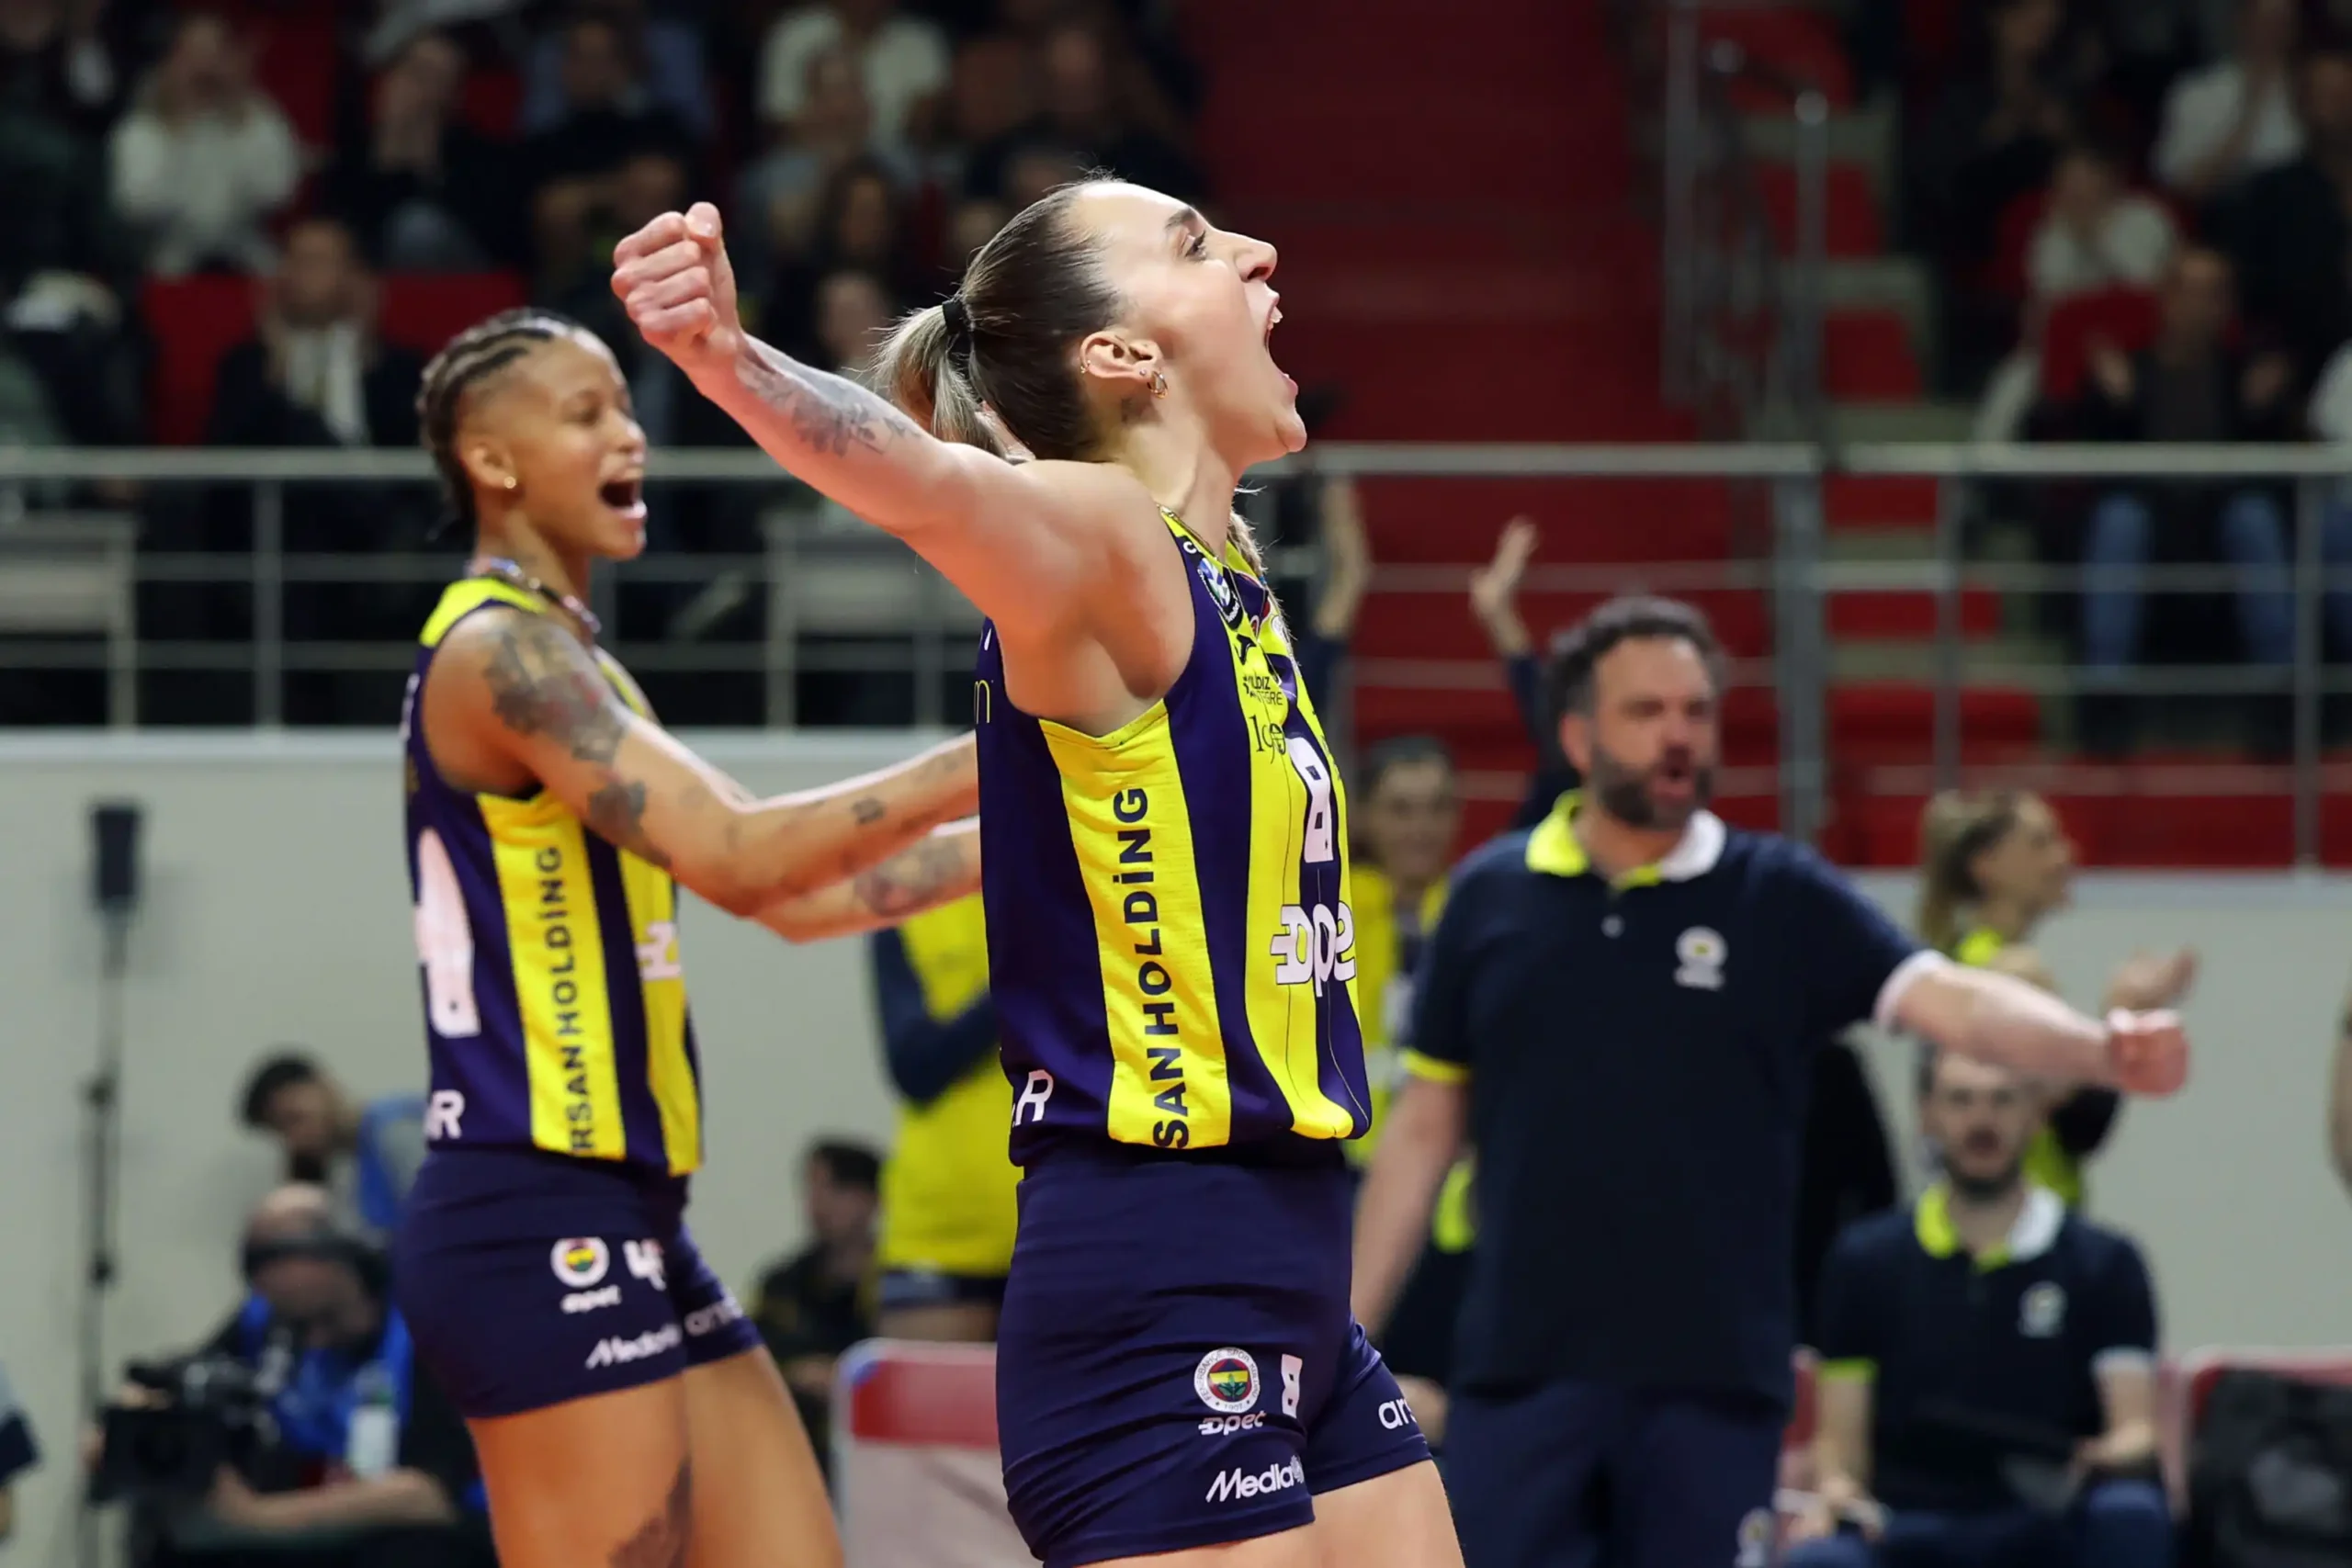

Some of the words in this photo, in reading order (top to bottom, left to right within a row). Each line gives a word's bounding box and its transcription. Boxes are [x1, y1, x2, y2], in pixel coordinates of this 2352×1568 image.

[1286, 737, 1334, 863] 8
[623, 1239, 667, 1290] 4
[1281, 1354, 1303, 1419] 8
